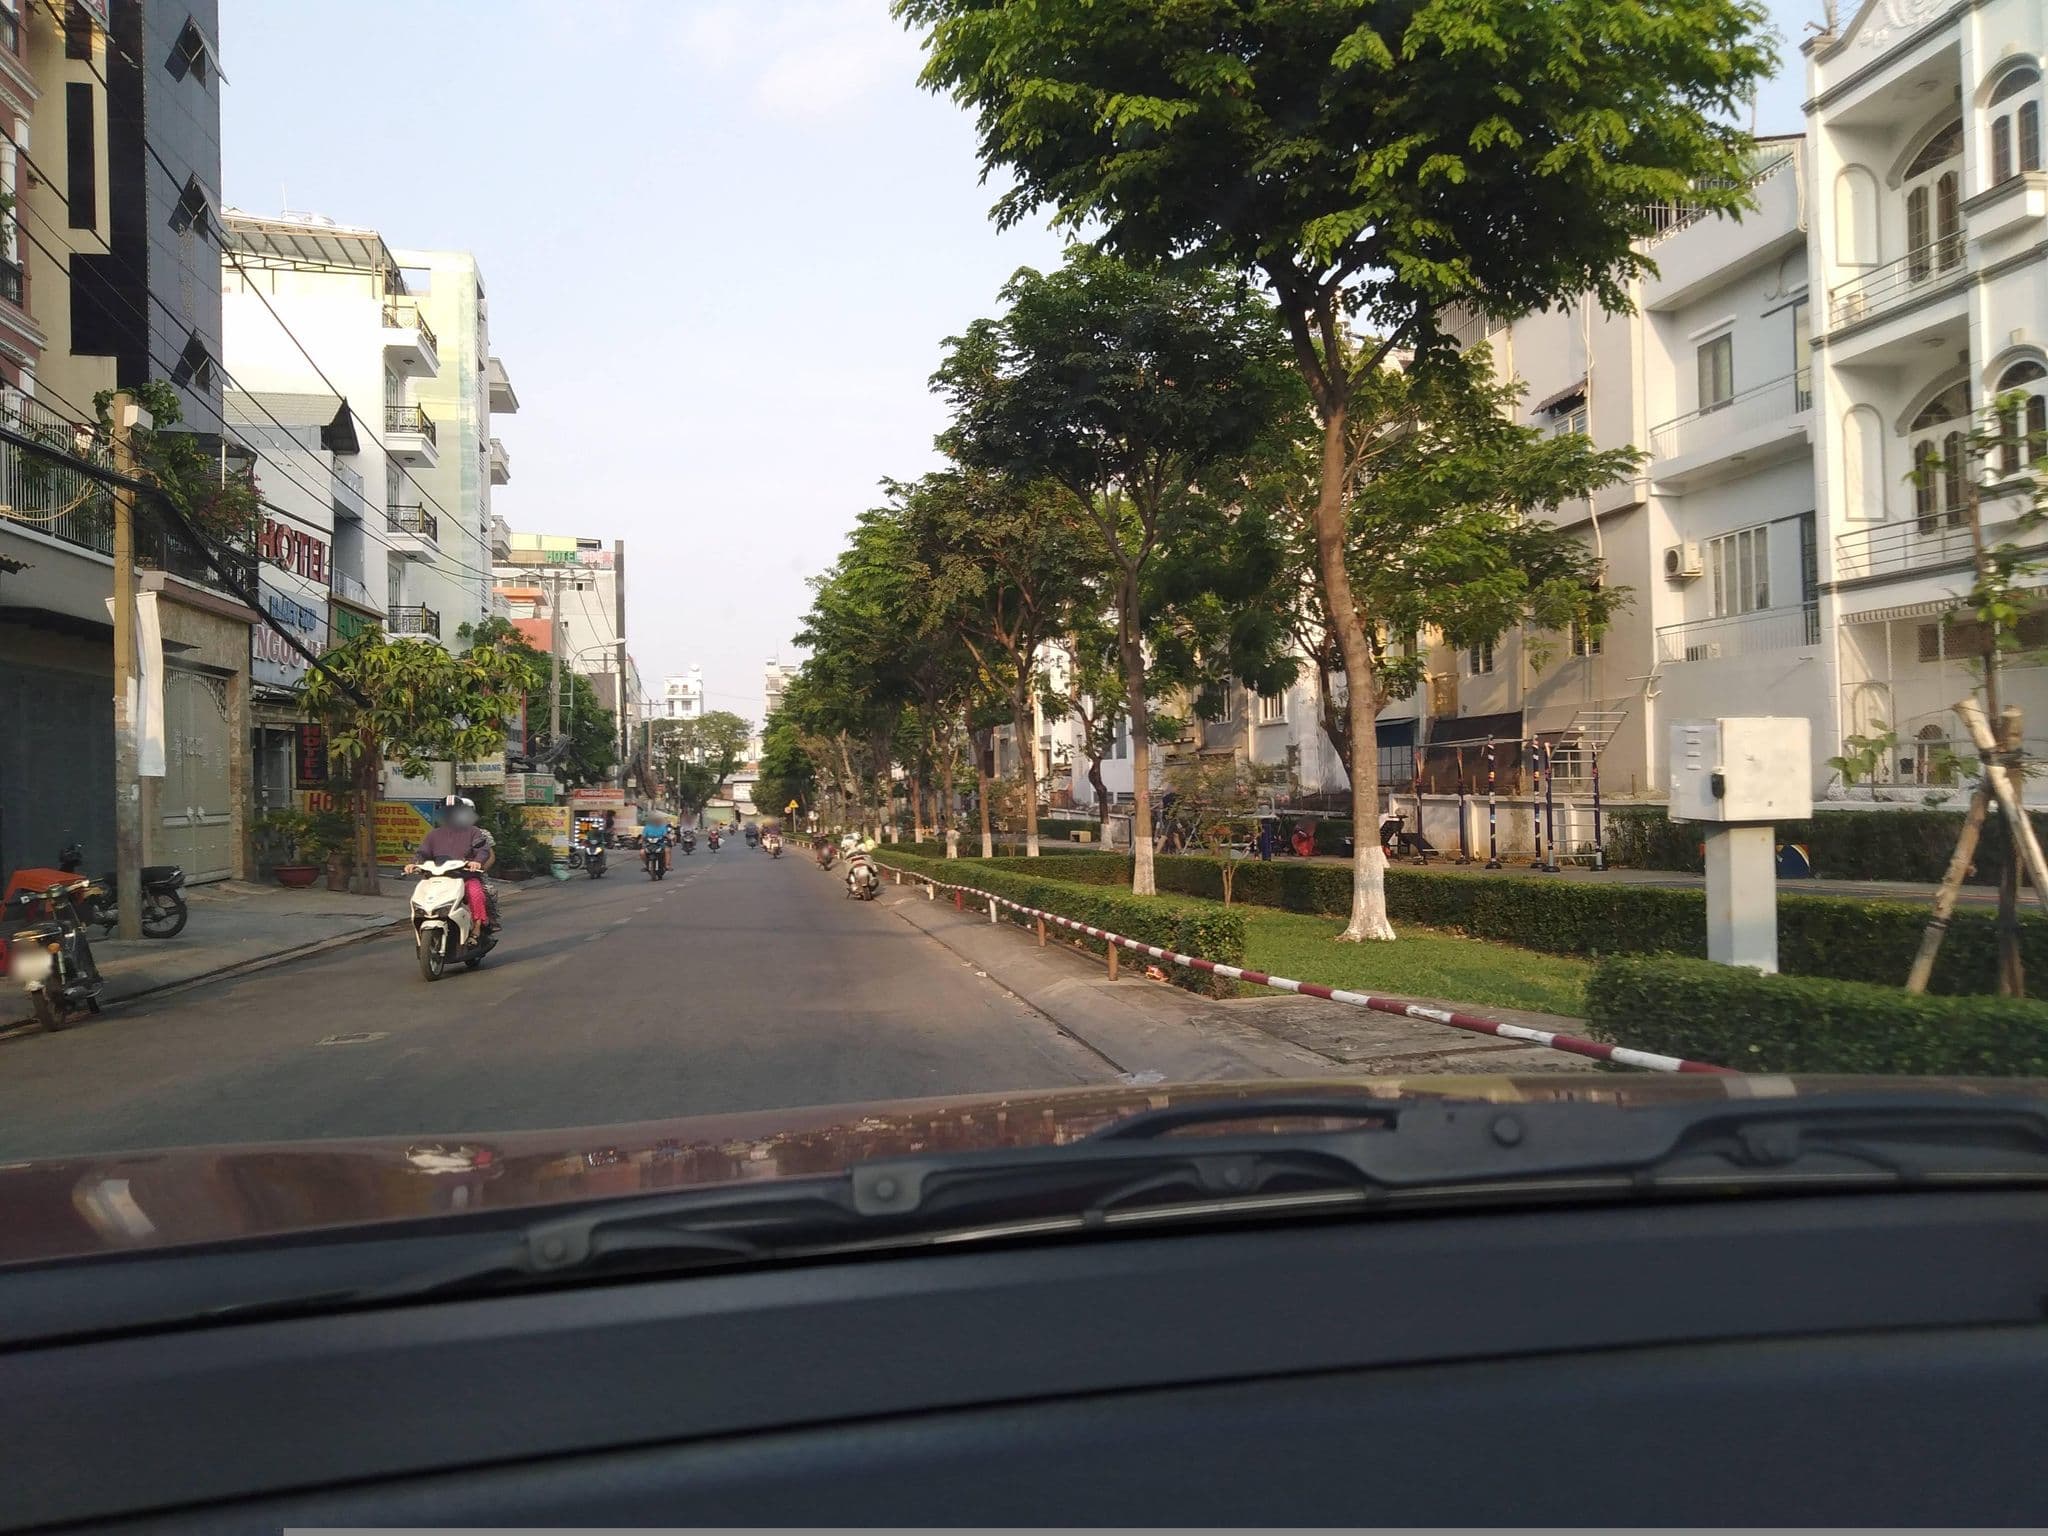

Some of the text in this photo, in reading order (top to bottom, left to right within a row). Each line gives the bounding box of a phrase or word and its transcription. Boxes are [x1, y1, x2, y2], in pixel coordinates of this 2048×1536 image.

[257, 518, 329, 586] HOTEL
[544, 550, 577, 563] HOTEL
[376, 806, 408, 815] HOTEL
